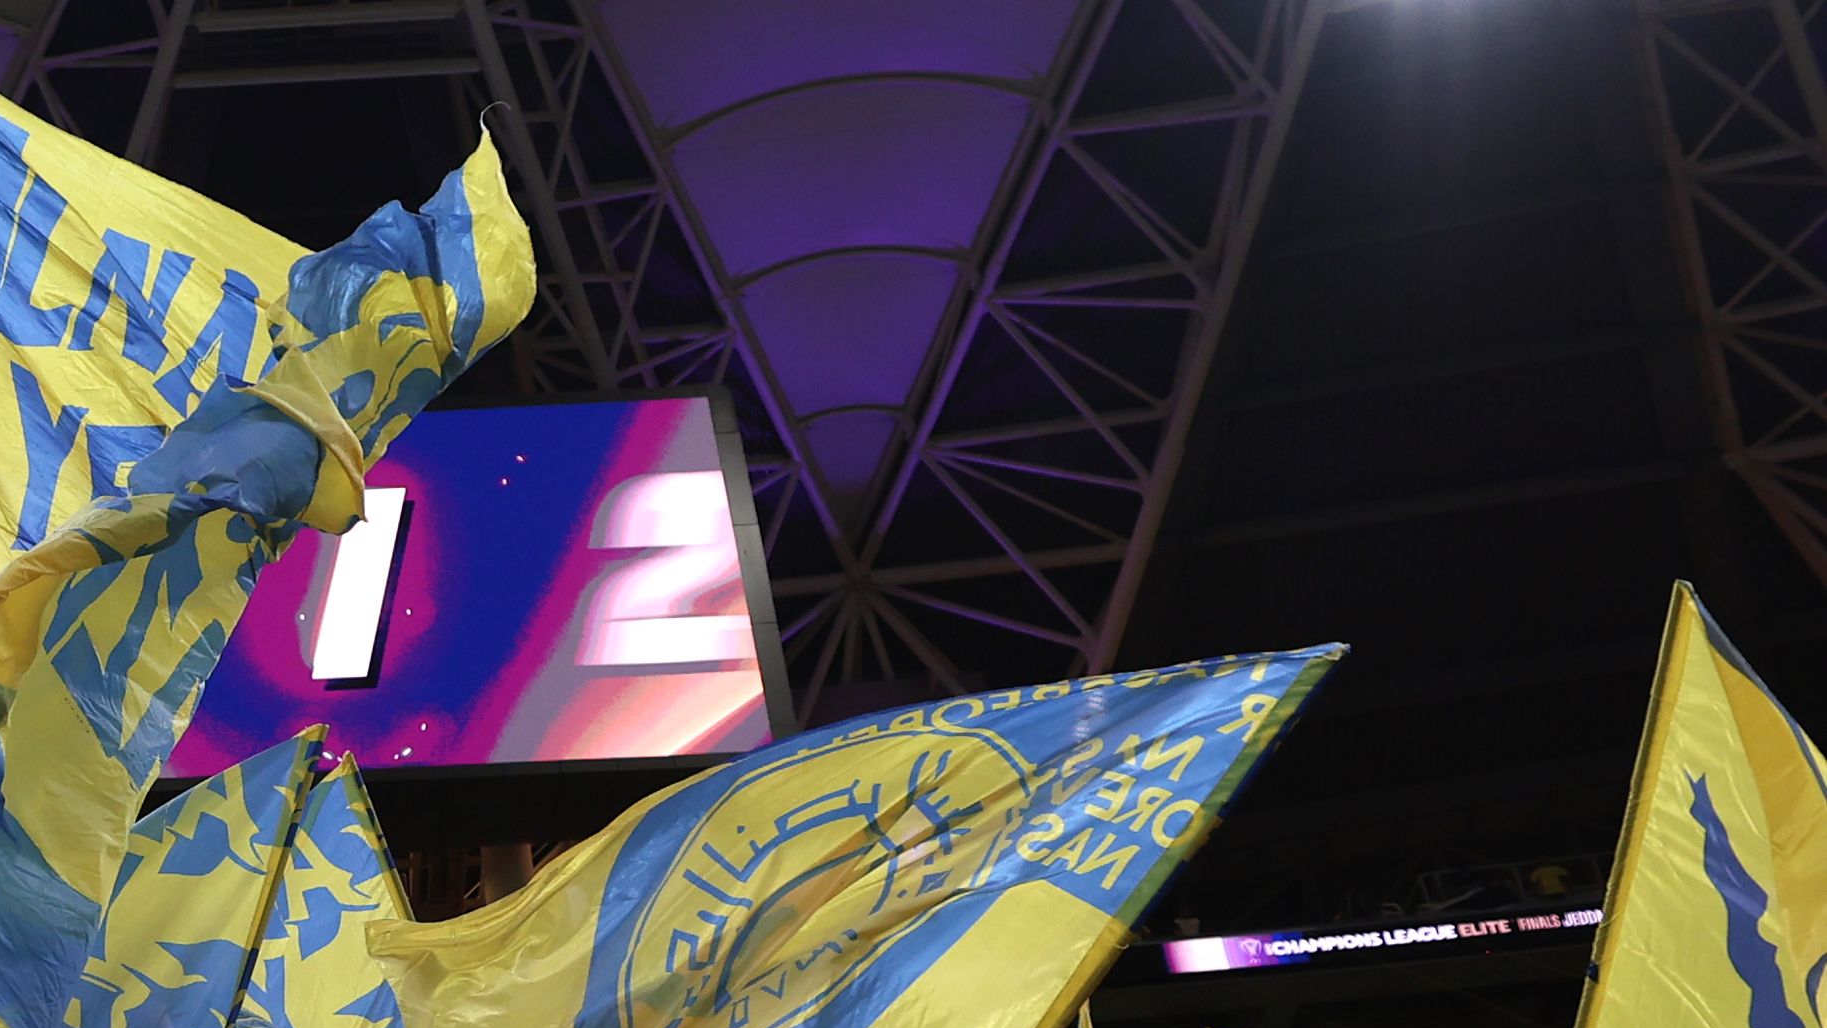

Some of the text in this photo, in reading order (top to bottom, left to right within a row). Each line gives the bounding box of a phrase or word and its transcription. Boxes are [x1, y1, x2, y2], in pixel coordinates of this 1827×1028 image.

[1270, 931, 1383, 957] CHAMPIONS
[1383, 924, 1459, 946] LEAGUE
[1458, 919, 1512, 938] ELITE
[1516, 914, 1561, 932] FINALS
